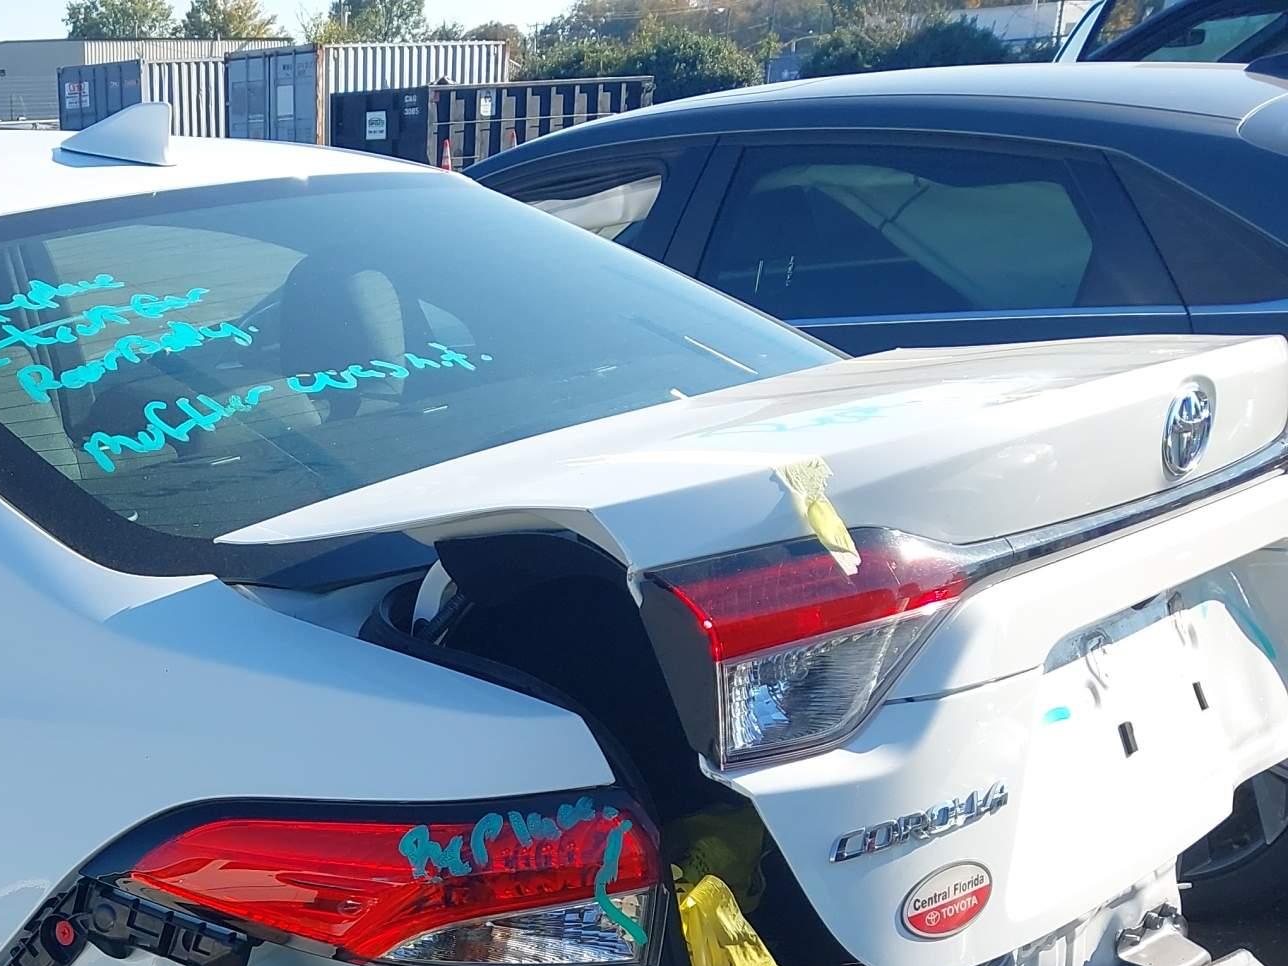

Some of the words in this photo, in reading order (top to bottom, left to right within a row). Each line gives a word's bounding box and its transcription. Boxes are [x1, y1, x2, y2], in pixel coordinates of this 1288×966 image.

[829, 779, 1009, 863] COROLLA
[913, 885, 951, 911] Central
[953, 874, 985, 896] Florida
[941, 895, 979, 919] TOYOTA
